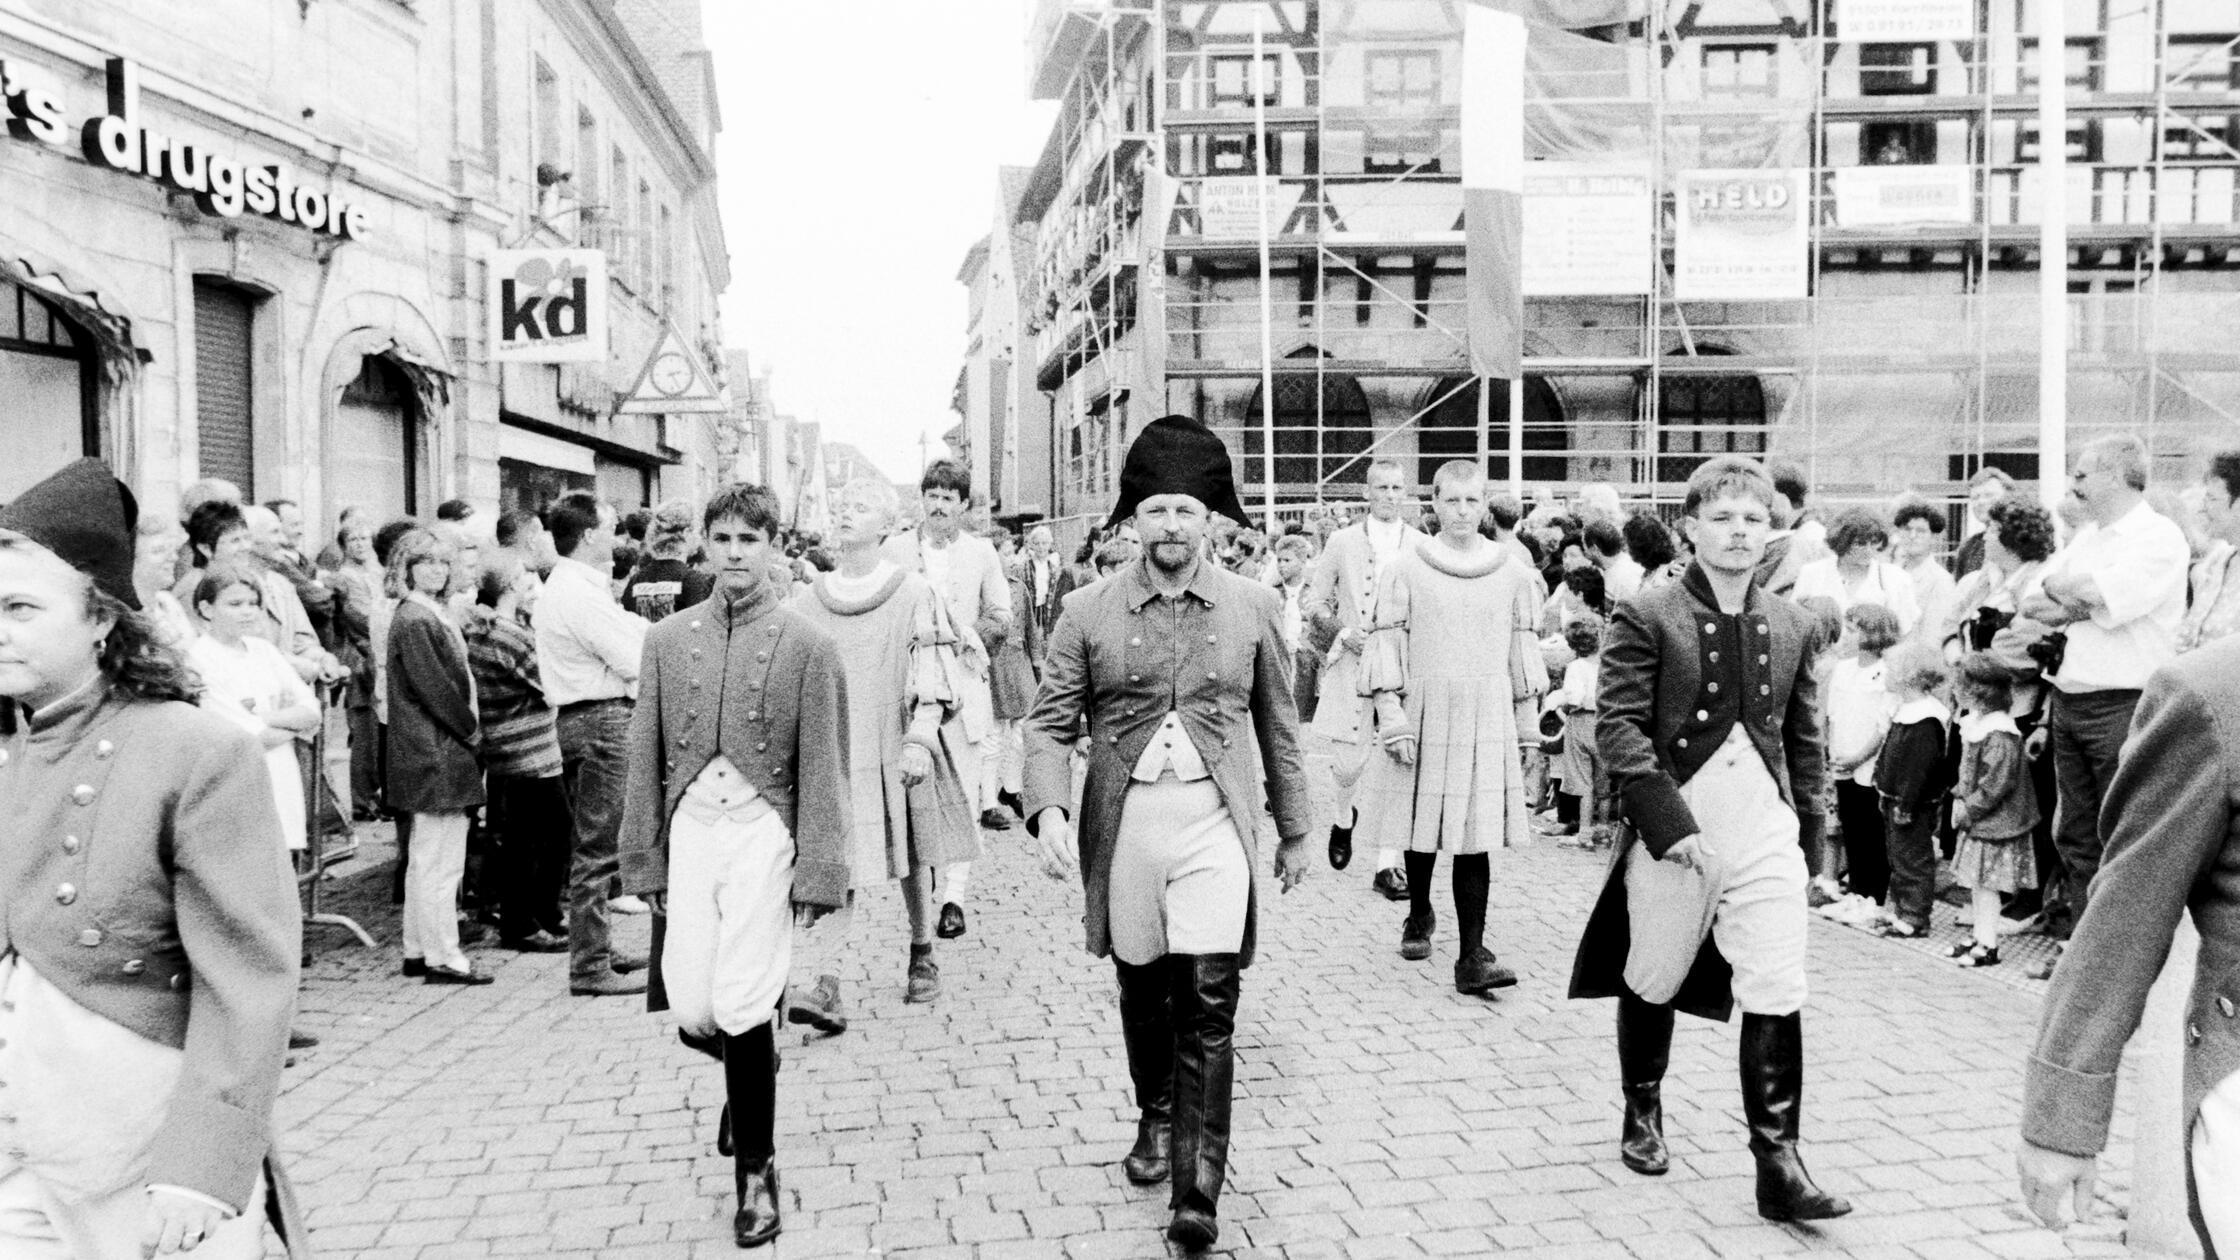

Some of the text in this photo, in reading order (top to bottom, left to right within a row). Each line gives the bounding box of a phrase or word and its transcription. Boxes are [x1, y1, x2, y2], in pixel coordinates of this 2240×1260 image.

[0, 57, 373, 242] 's drugstore
[1227, 198, 1276, 208] HOLZBU
[1247, 184, 1276, 196] HEM
[1697, 182, 1789, 209] HELD
[501, 277, 587, 341] kd
